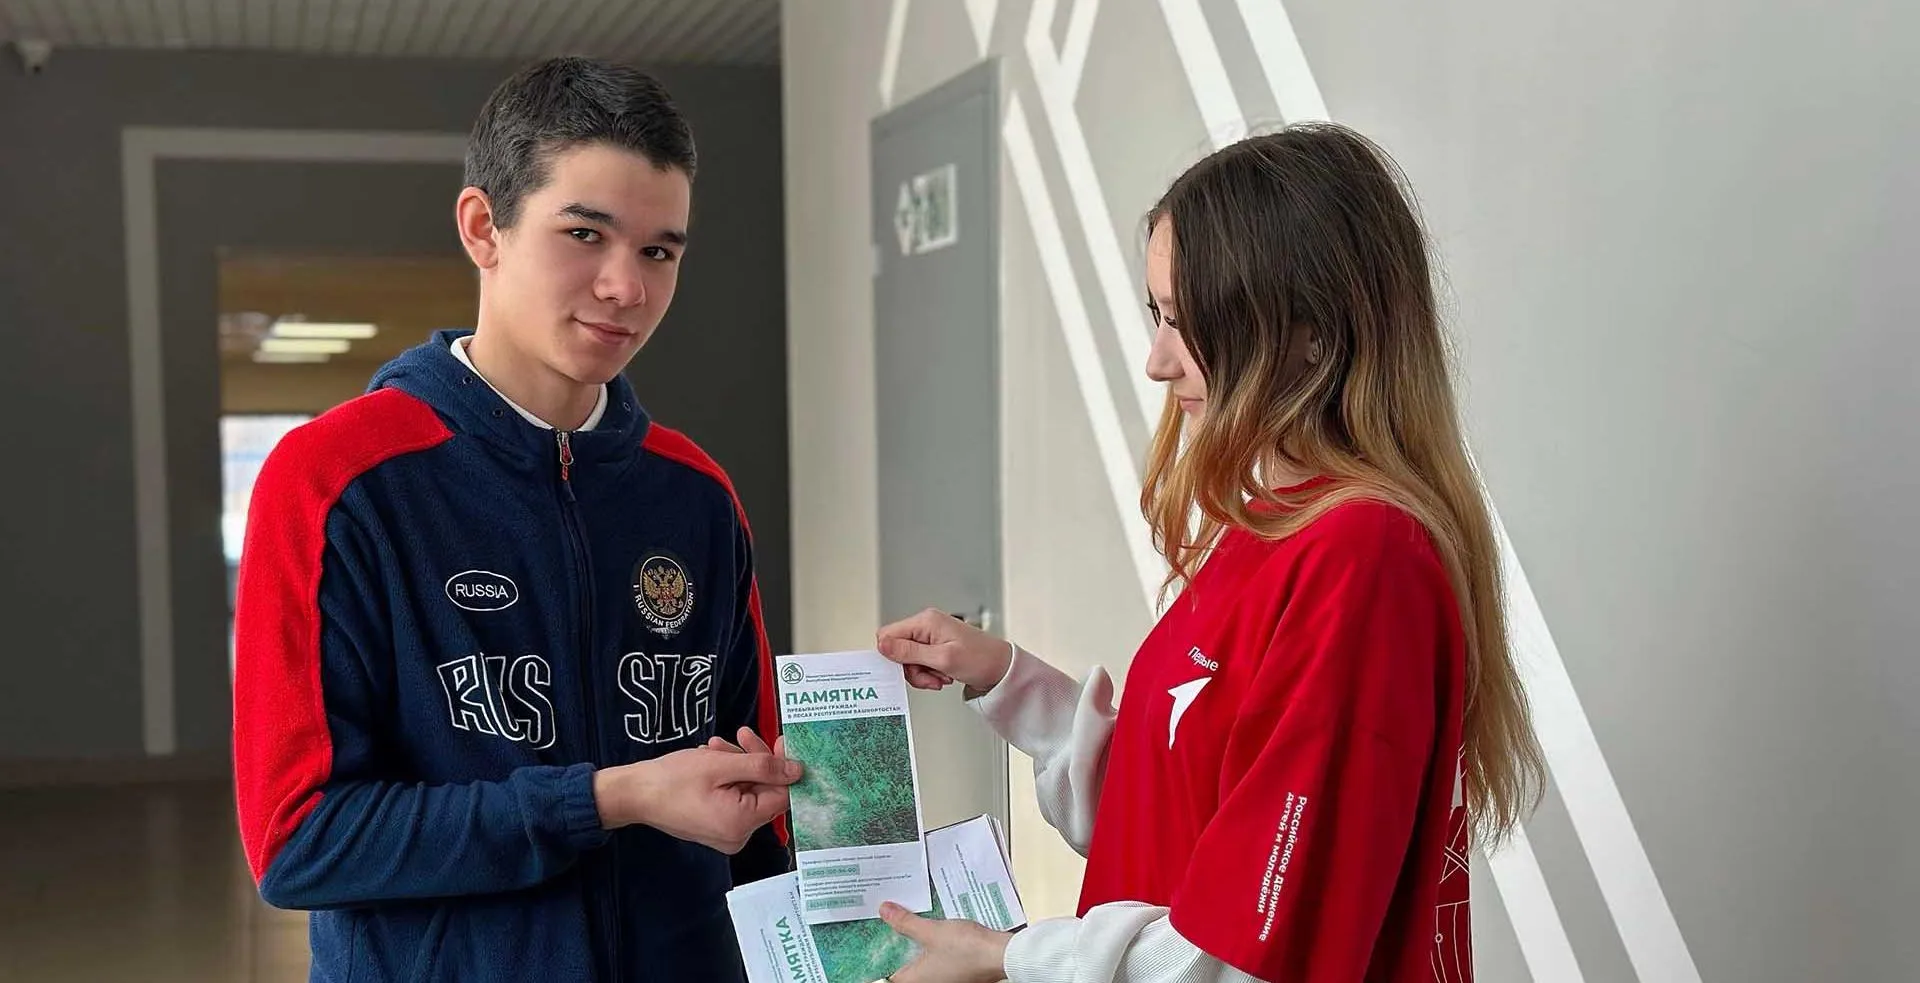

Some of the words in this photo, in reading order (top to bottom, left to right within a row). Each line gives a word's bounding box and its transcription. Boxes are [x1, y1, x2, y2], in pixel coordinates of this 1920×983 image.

[455, 583, 508, 599] RUSSIA
[634, 594, 664, 626] RUSSIAN
[665, 592, 694, 628] FEDERATION
[785, 687, 879, 705] ПАМЯТКА
[1278, 792, 1294, 831] детей
[1275, 833, 1283, 843] и
[1278, 796, 1307, 873] Российское
[1257, 844, 1280, 914] молодёжи
[1259, 874, 1284, 941] движение
